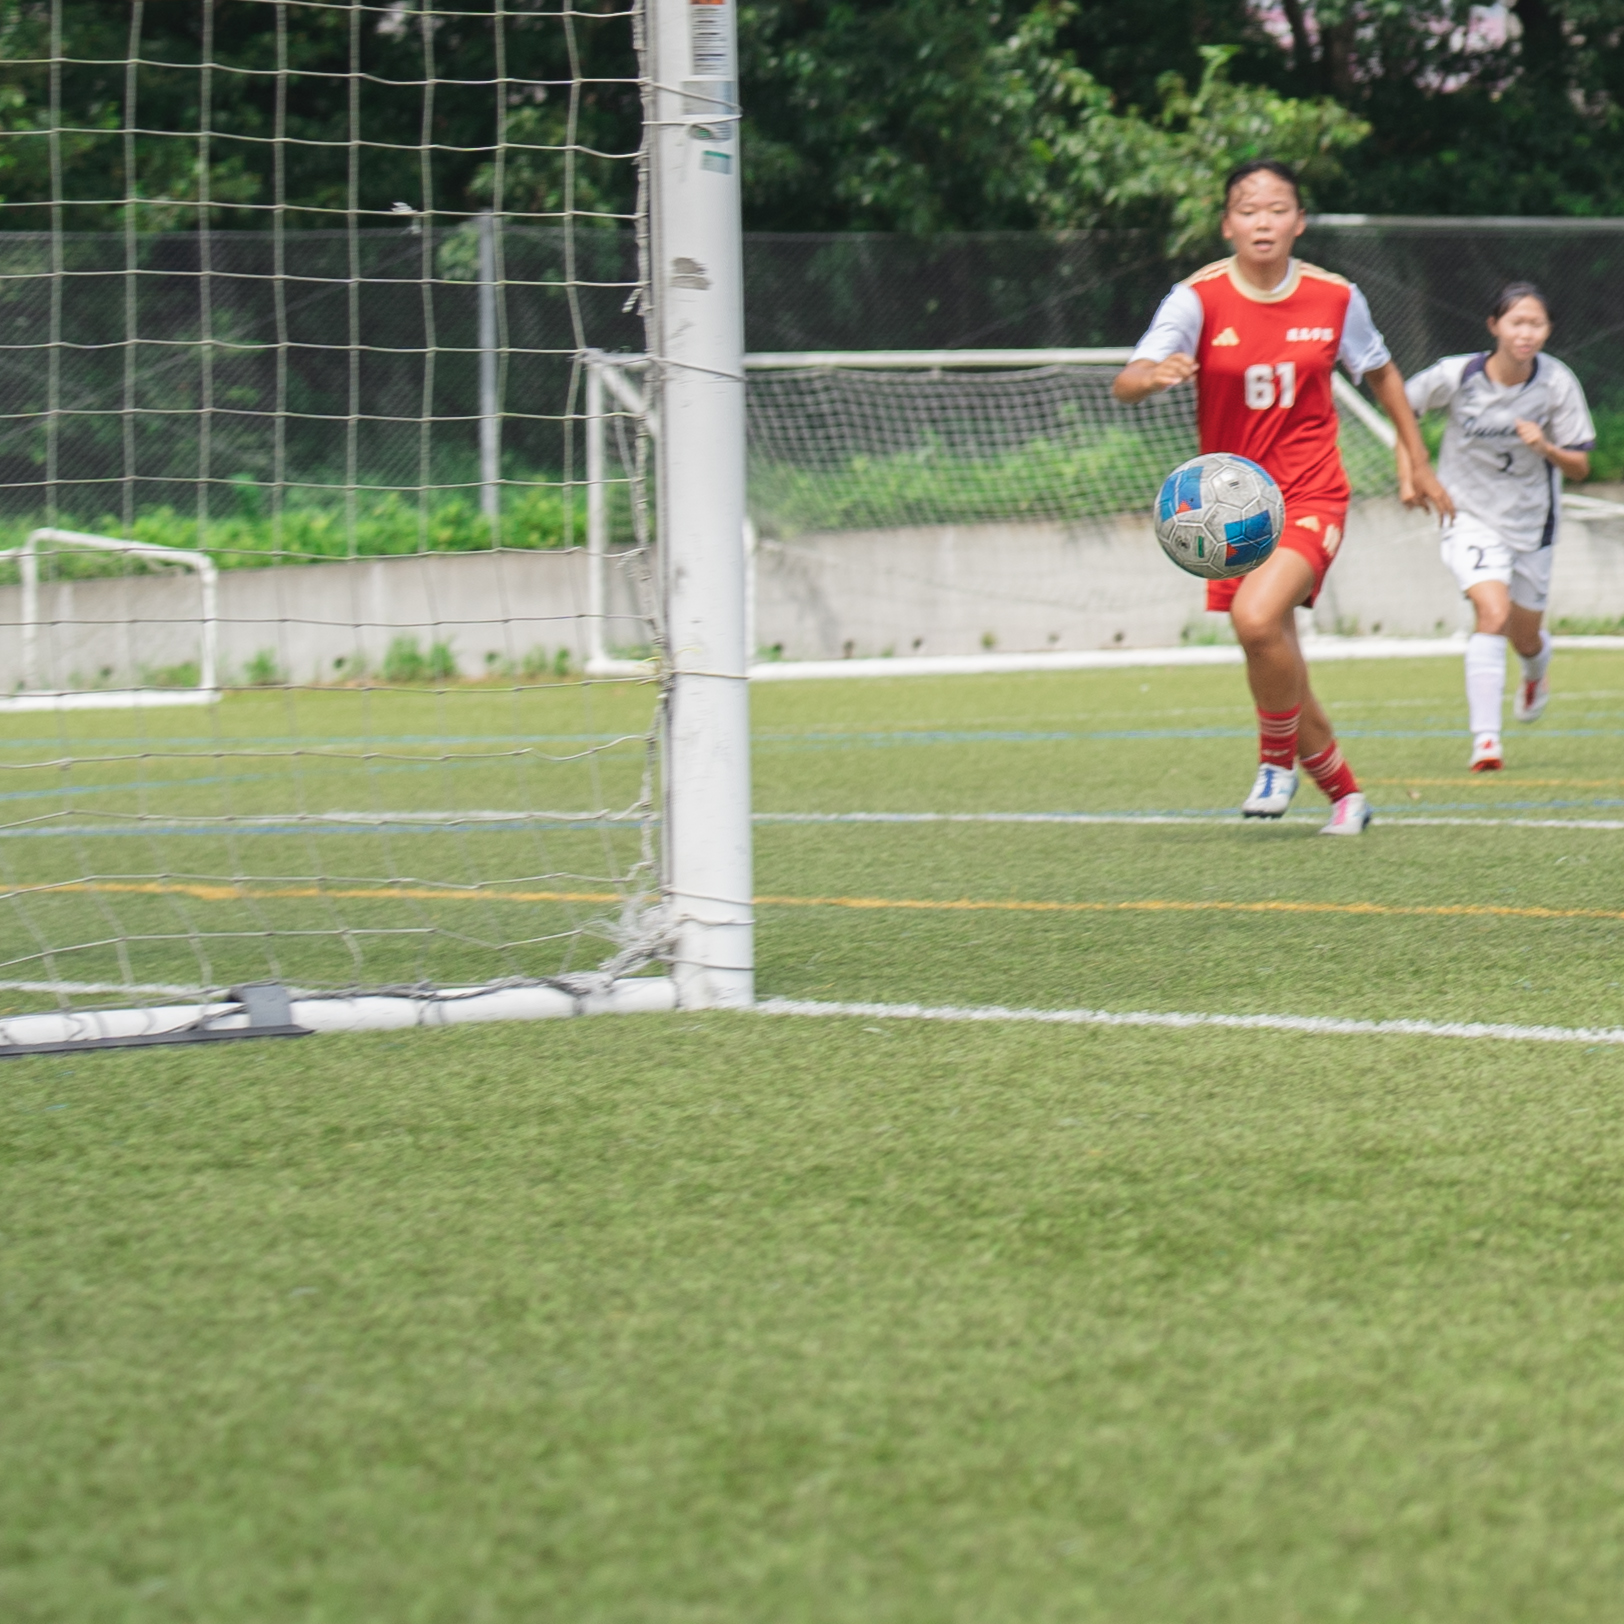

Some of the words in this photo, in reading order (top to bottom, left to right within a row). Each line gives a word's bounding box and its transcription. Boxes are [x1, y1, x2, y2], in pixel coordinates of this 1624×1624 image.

[1244, 362, 1296, 410] 61
[1495, 451, 1513, 476] 2
[1467, 544, 1489, 570] 2
